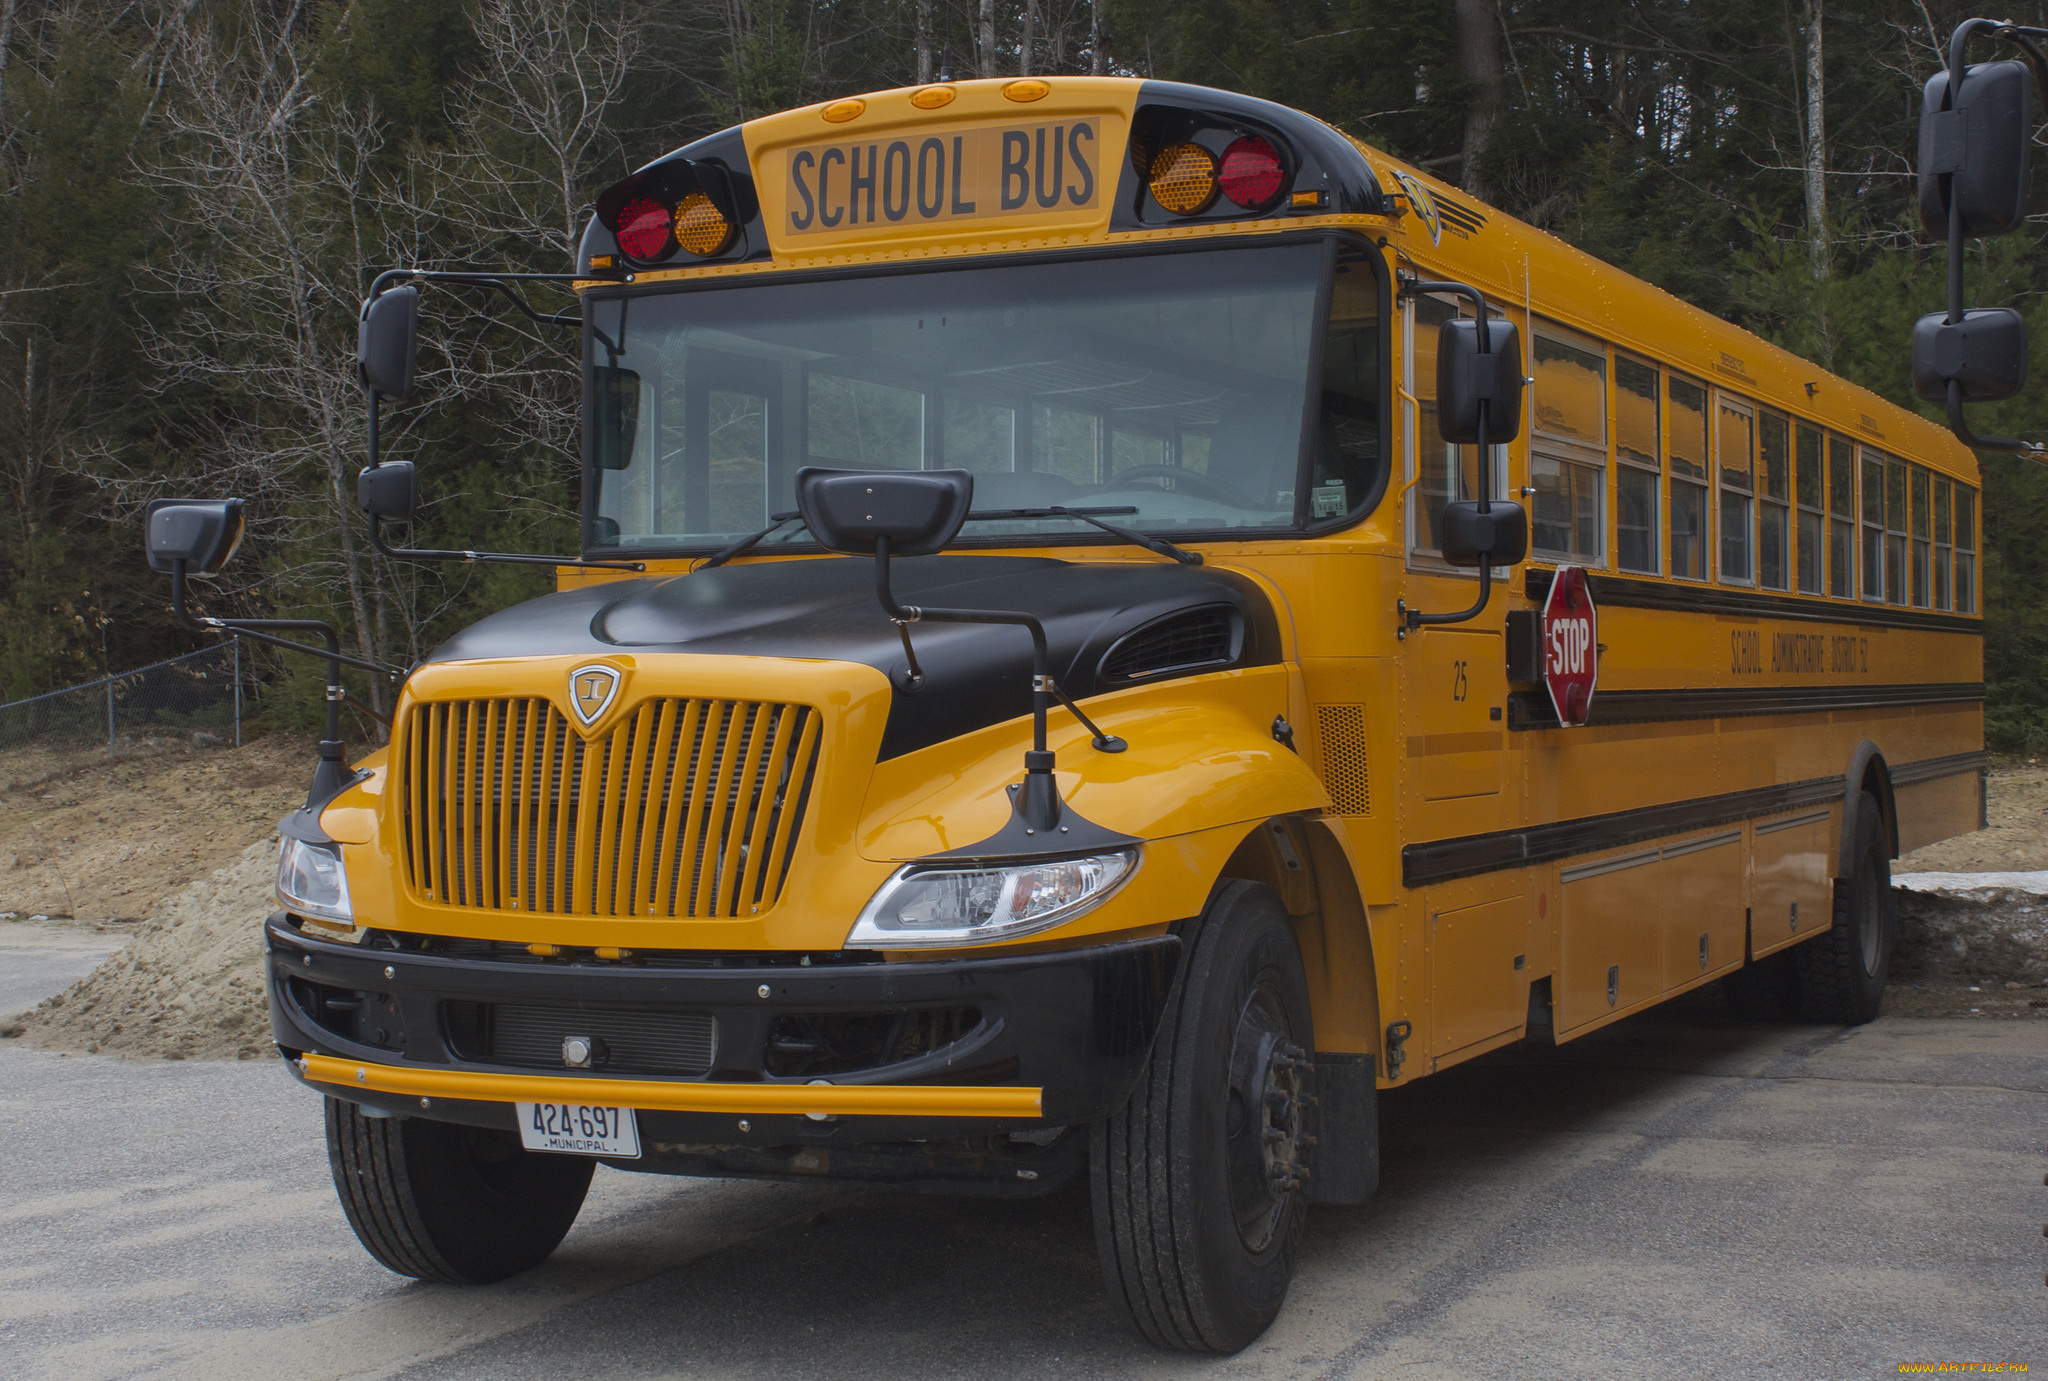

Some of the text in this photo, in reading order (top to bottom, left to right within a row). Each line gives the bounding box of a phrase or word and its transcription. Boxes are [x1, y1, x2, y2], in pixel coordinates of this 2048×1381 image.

[790, 122, 1095, 231] SCHOOL BUS
[1551, 618, 1590, 675] STOP
[1731, 629, 1762, 674] SCHOOL
[1454, 660, 1468, 702] 25
[549, 1138, 610, 1152] MUNICIPAL
